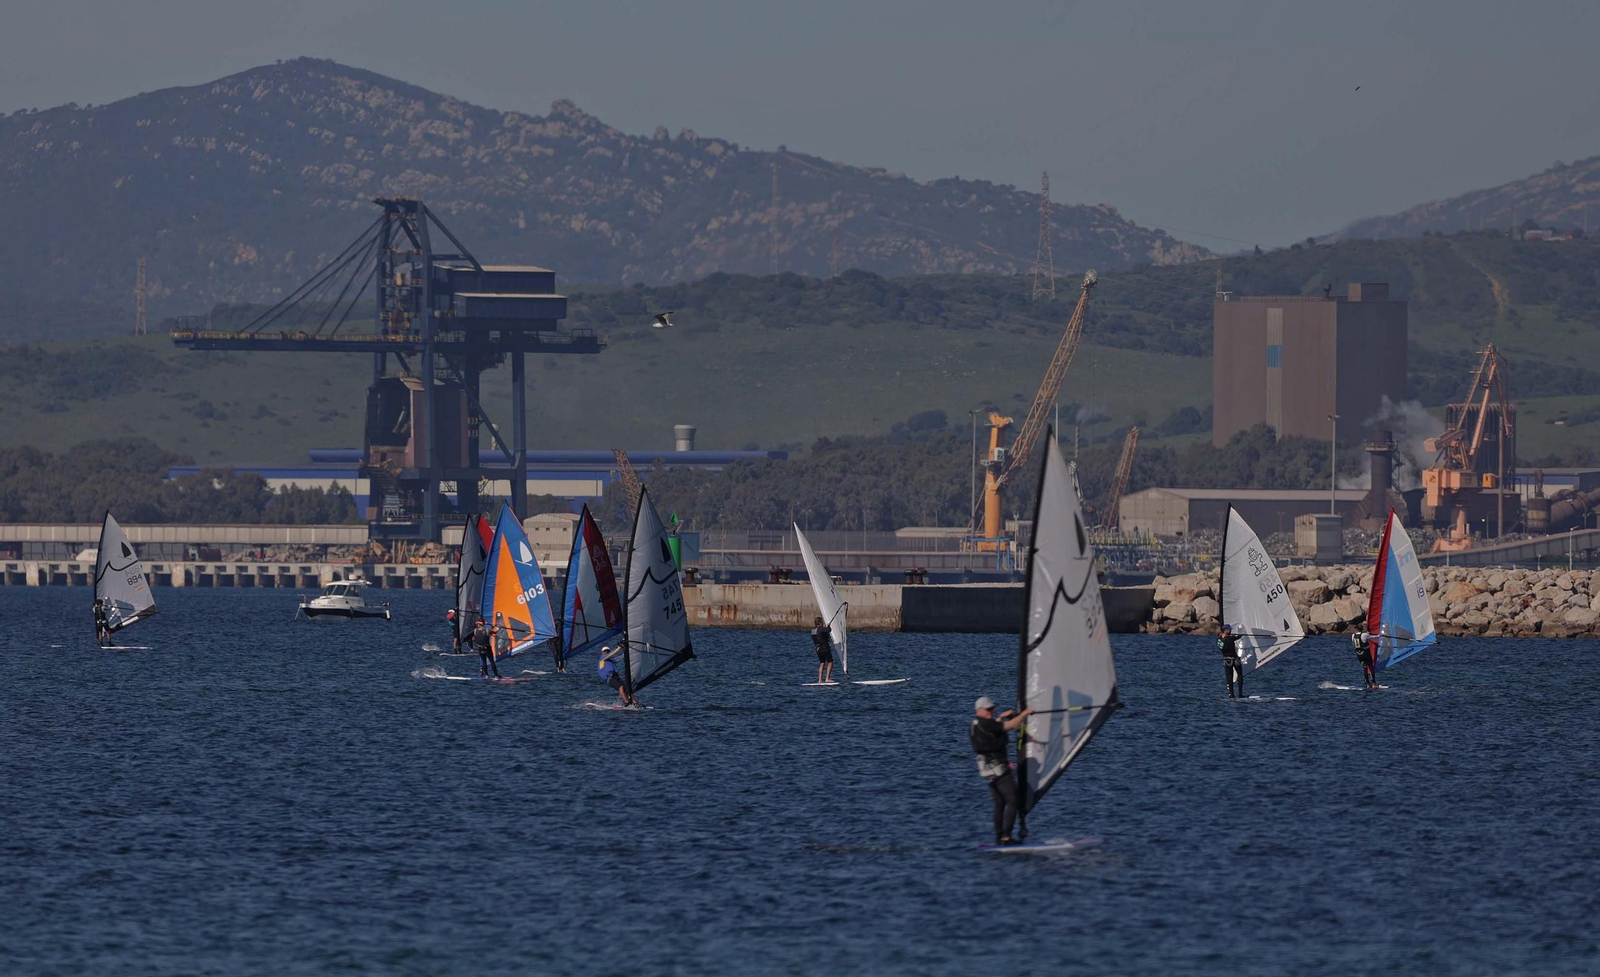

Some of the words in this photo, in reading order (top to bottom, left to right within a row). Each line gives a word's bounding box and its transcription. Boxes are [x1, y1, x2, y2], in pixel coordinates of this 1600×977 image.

[127, 573, 143, 586] 894
[516, 583, 545, 605] 6103
[1266, 584, 1284, 604] 450
[663, 597, 682, 620] 745
